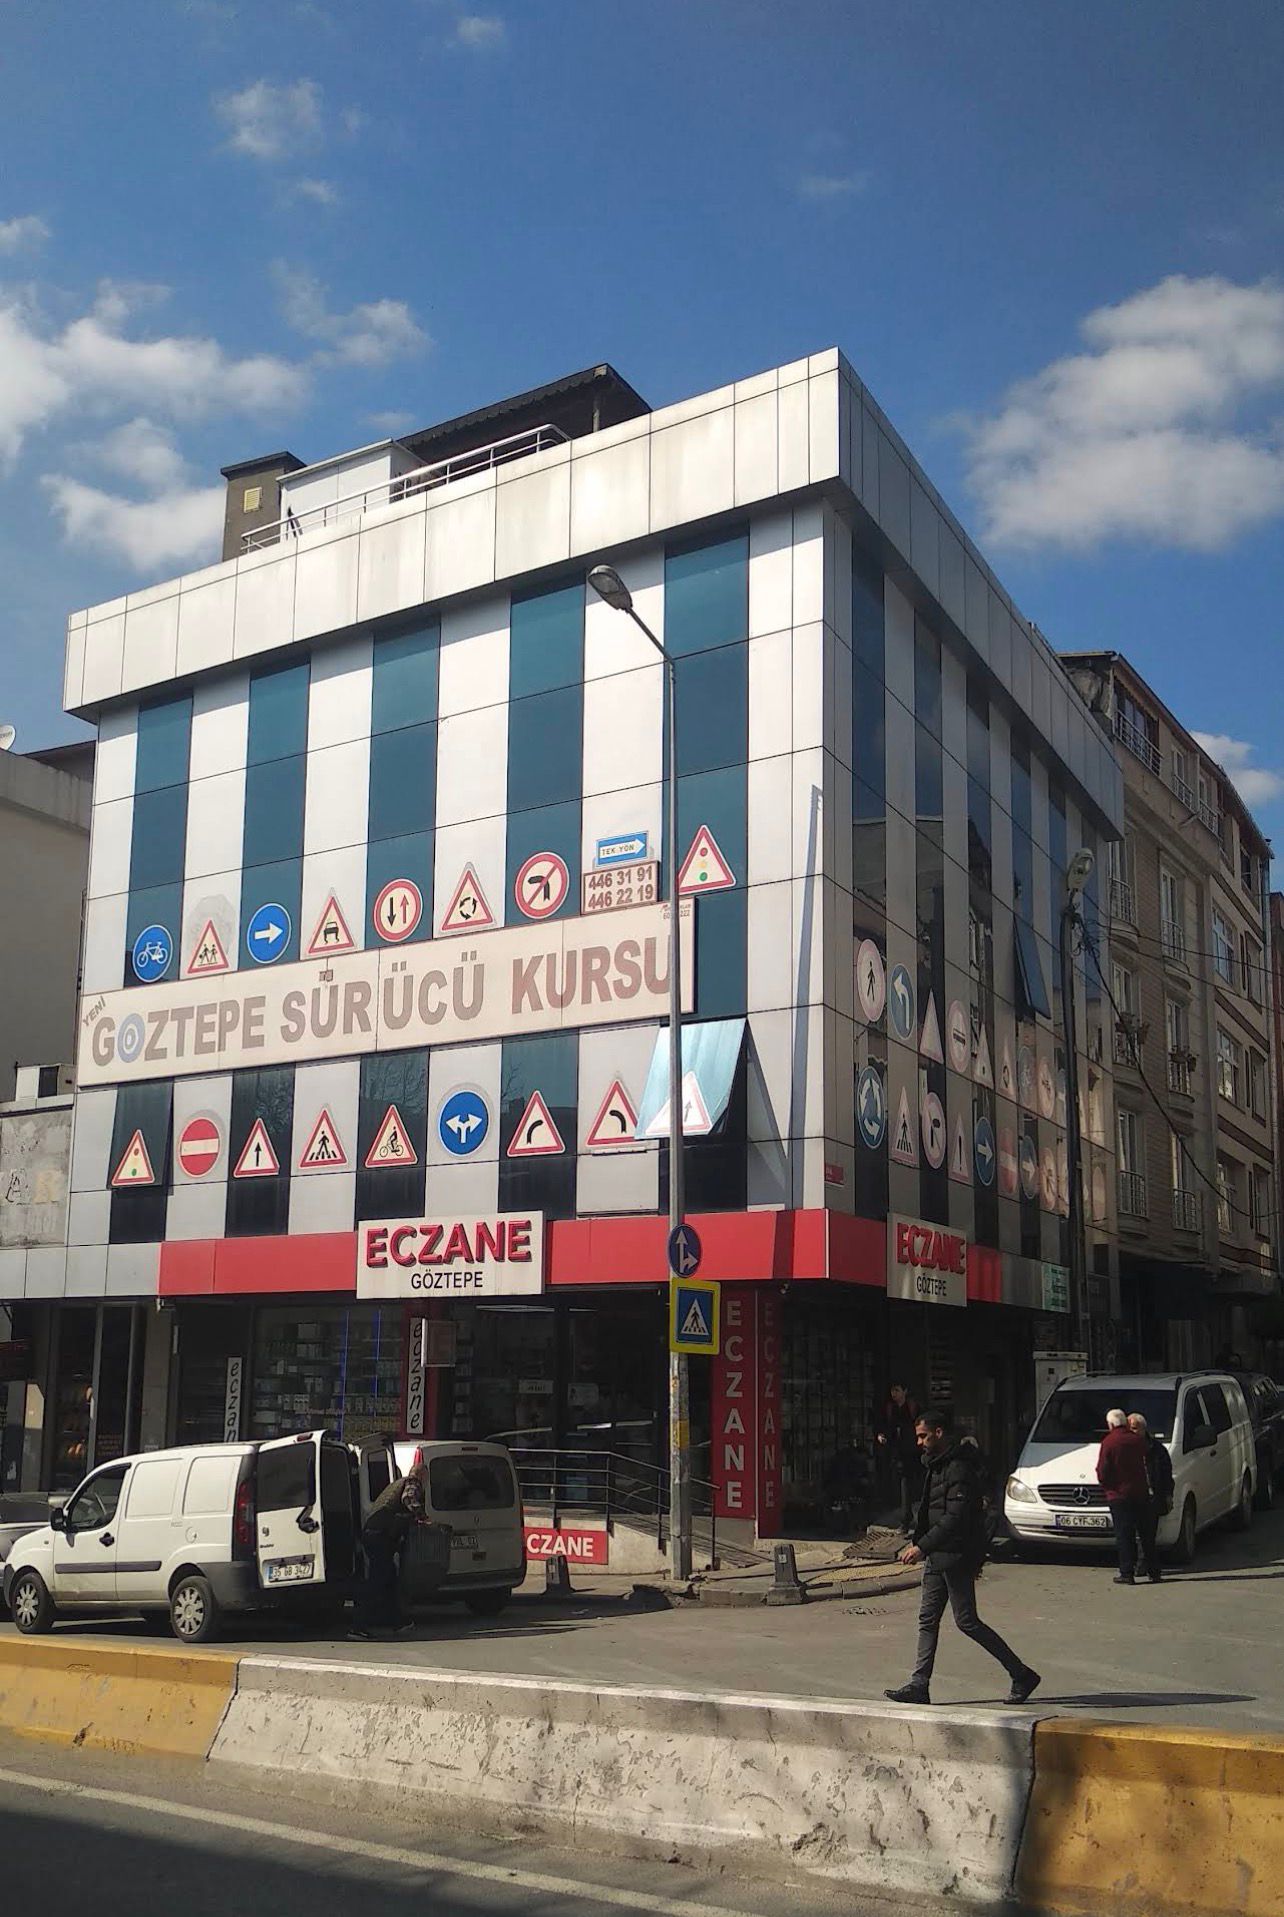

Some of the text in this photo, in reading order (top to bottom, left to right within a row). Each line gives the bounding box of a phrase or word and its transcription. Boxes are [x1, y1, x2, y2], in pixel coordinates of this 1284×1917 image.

[602, 847, 616, 856] TEK
[588, 865, 653, 891] 446 31 91
[588, 884, 654, 909] 446 22 19
[280, 950, 486, 1044] SÜRÜCÜ
[511, 934, 673, 1015] KURSU
[365, 1219, 532, 1269] ECZANE
[896, 1222, 966, 1275] ECZANE
[411, 1269, 484, 1290] GÖZTEPE
[917, 1273, 948, 1297] GÖZTEPE
[409, 1322, 422, 1430] eczane
[226, 1361, 240, 1443] eczan
[723, 1300, 746, 1509] ECZANE
[764, 1302, 776, 1509] ECZANE
[526, 1533, 594, 1558] CZANE
